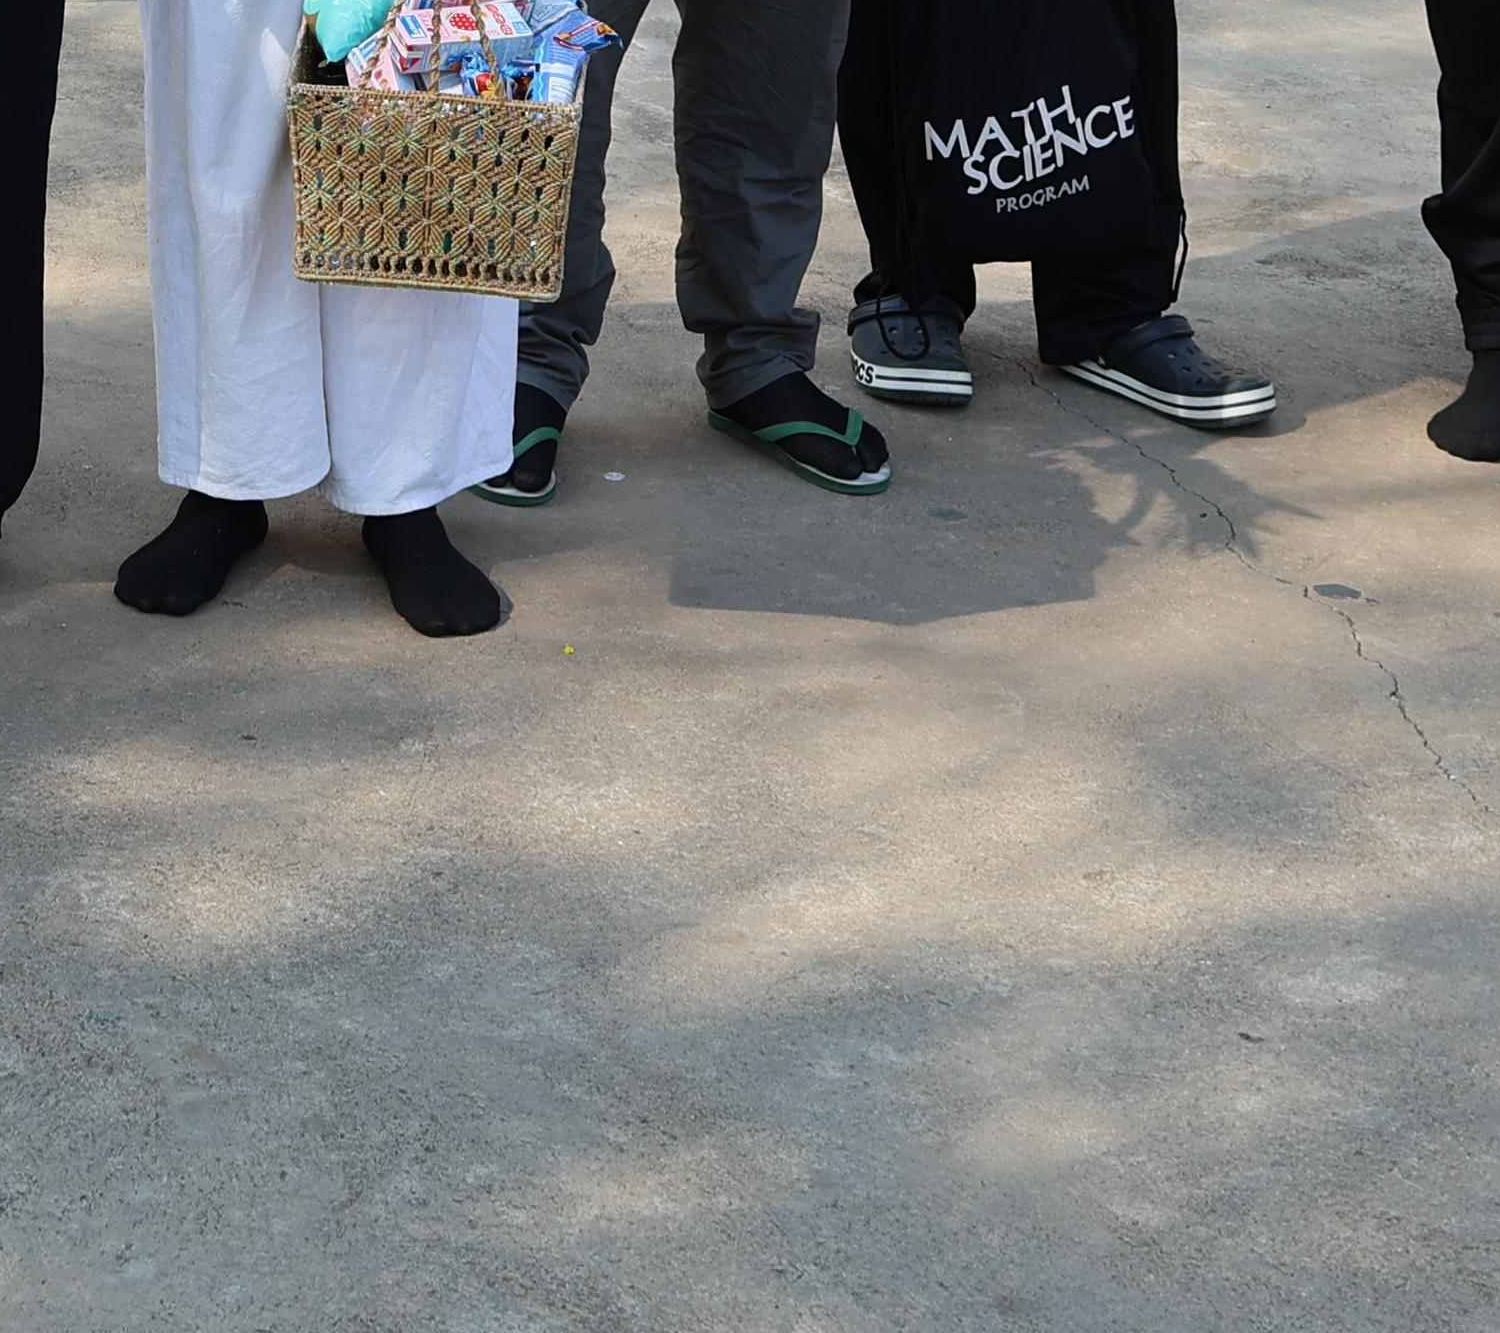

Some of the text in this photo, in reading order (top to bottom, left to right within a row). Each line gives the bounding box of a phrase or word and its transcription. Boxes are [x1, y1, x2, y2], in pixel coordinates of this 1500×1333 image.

[923, 84, 1077, 161] MATH
[962, 95, 1136, 196] SCIENCE
[995, 175, 1091, 214] PROGRAM
